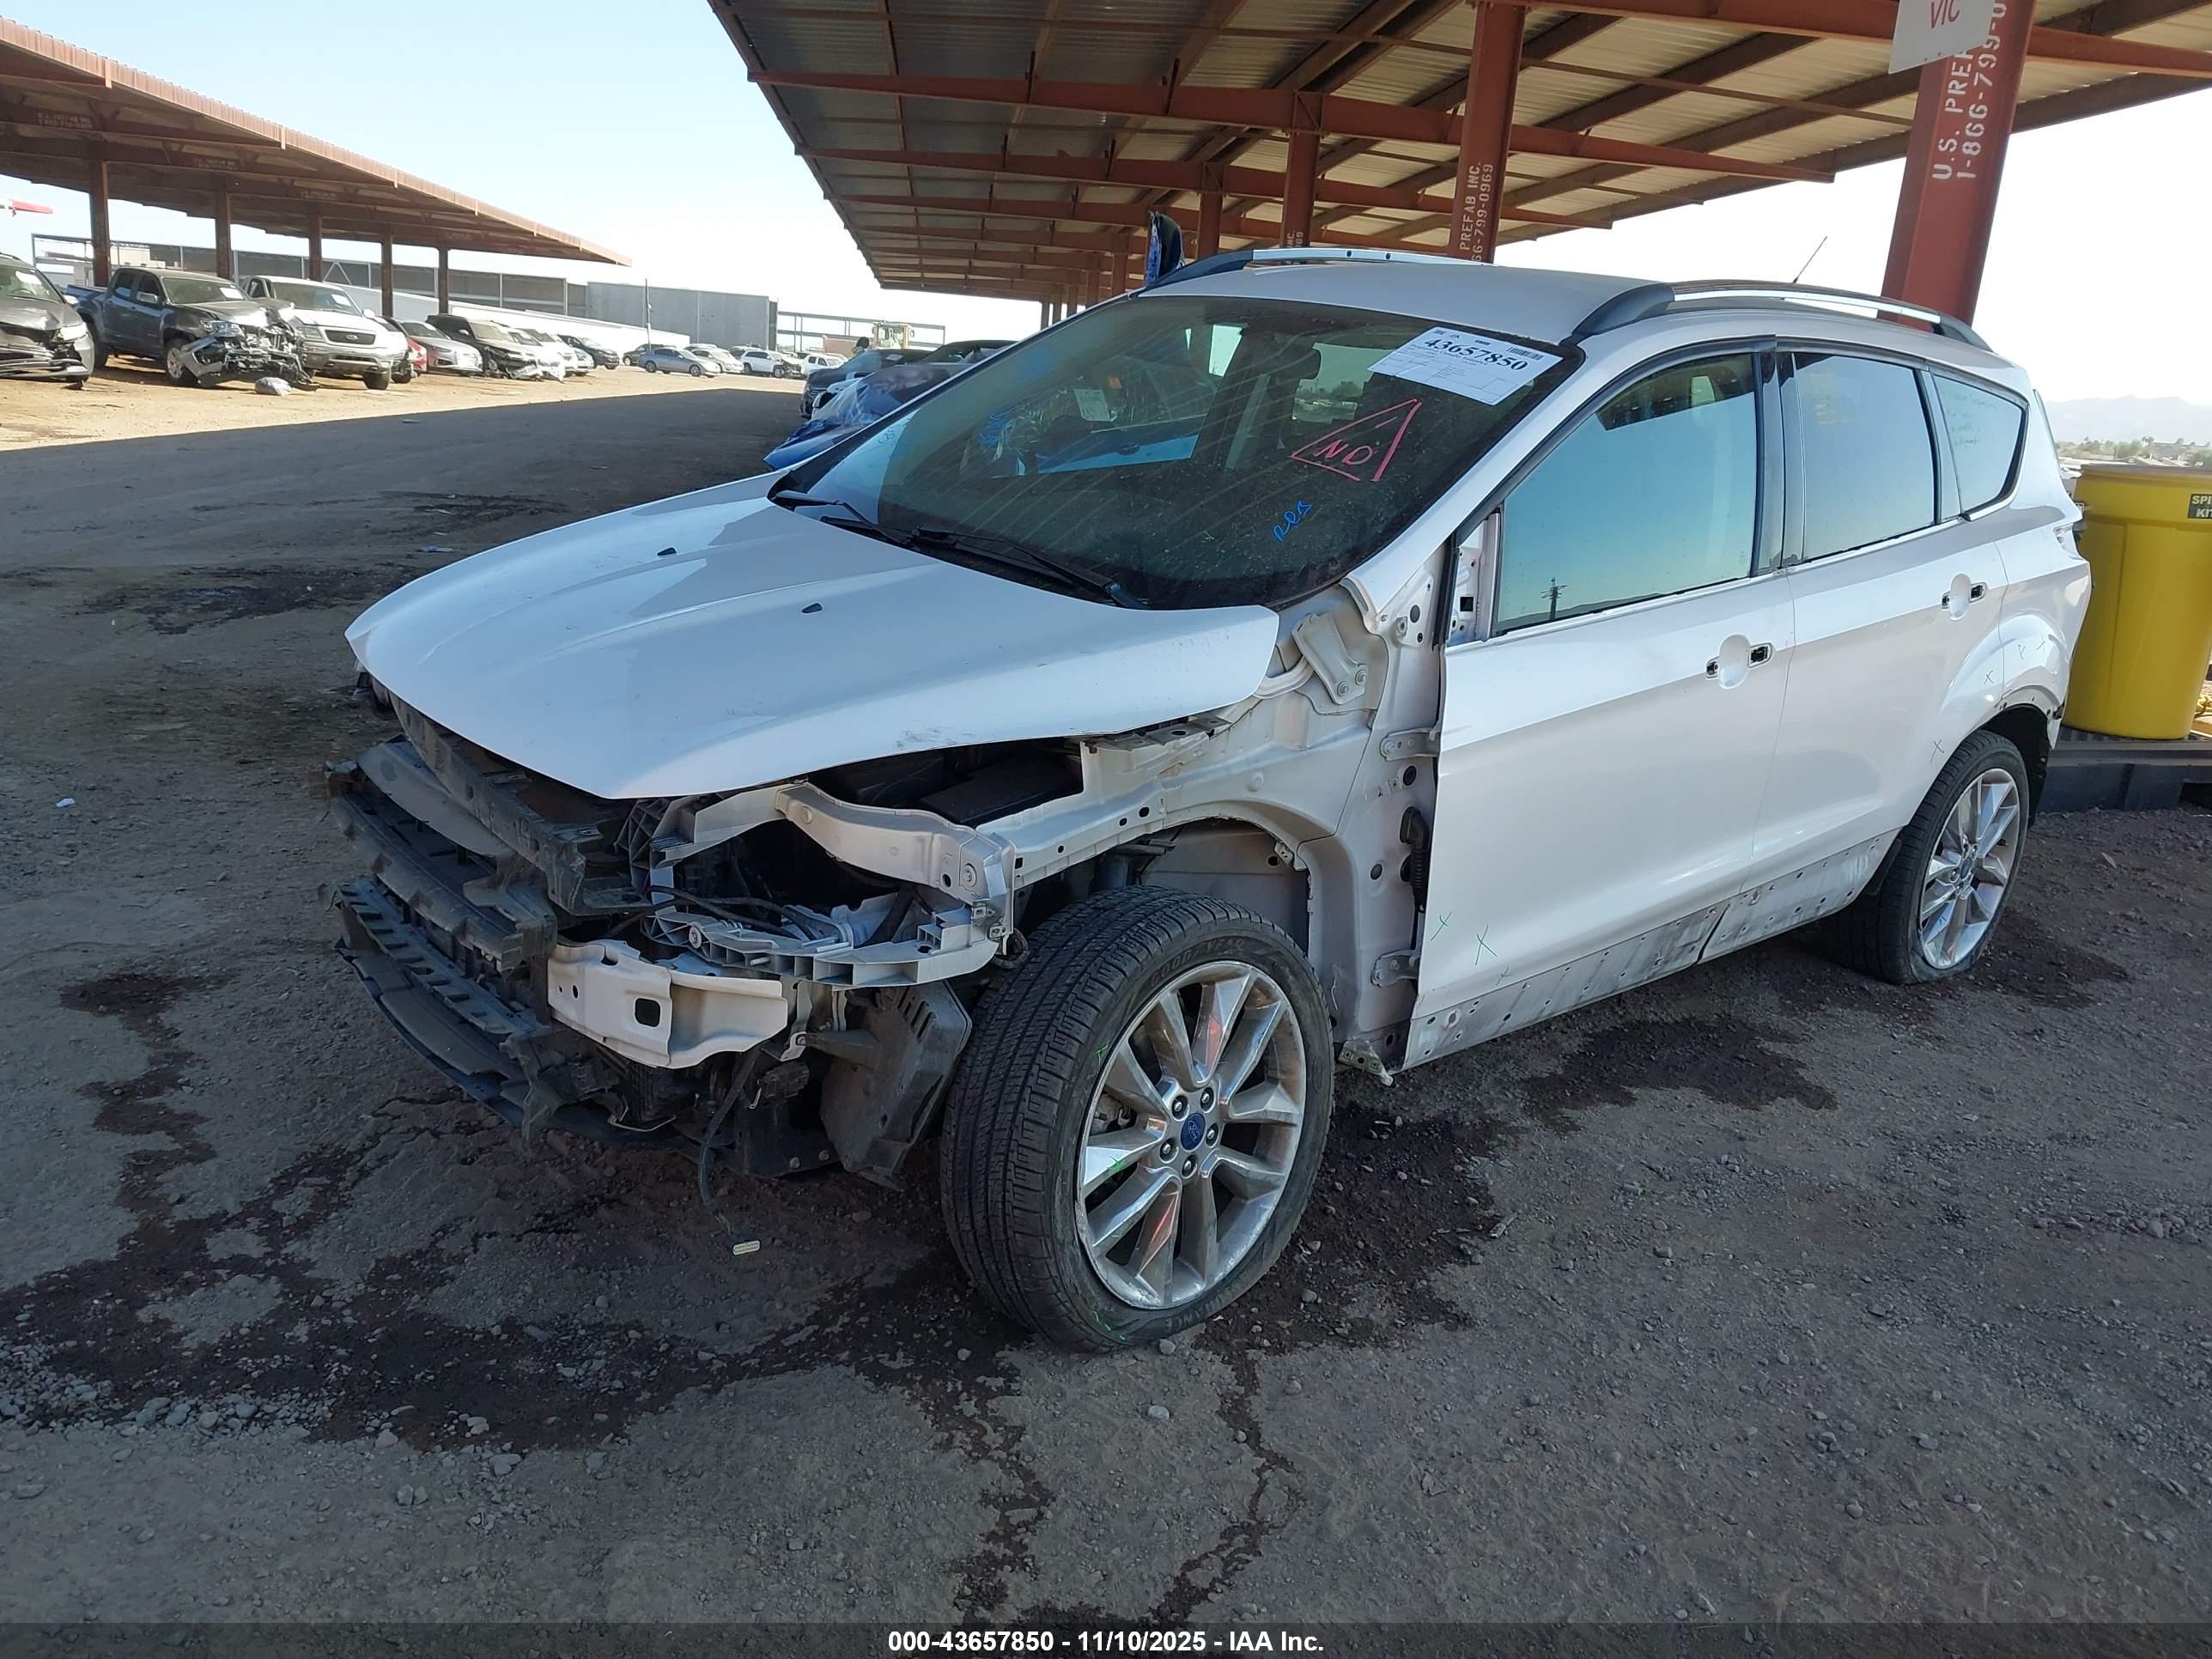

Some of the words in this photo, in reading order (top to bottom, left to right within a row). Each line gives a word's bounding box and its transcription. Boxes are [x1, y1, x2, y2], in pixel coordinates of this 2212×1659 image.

[1932, 130, 1960, 179] U.S.
[1467, 161, 1481, 189] INC.
[1459, 195, 1476, 251] PREFAB
[1425, 339, 1528, 371] 43657850
